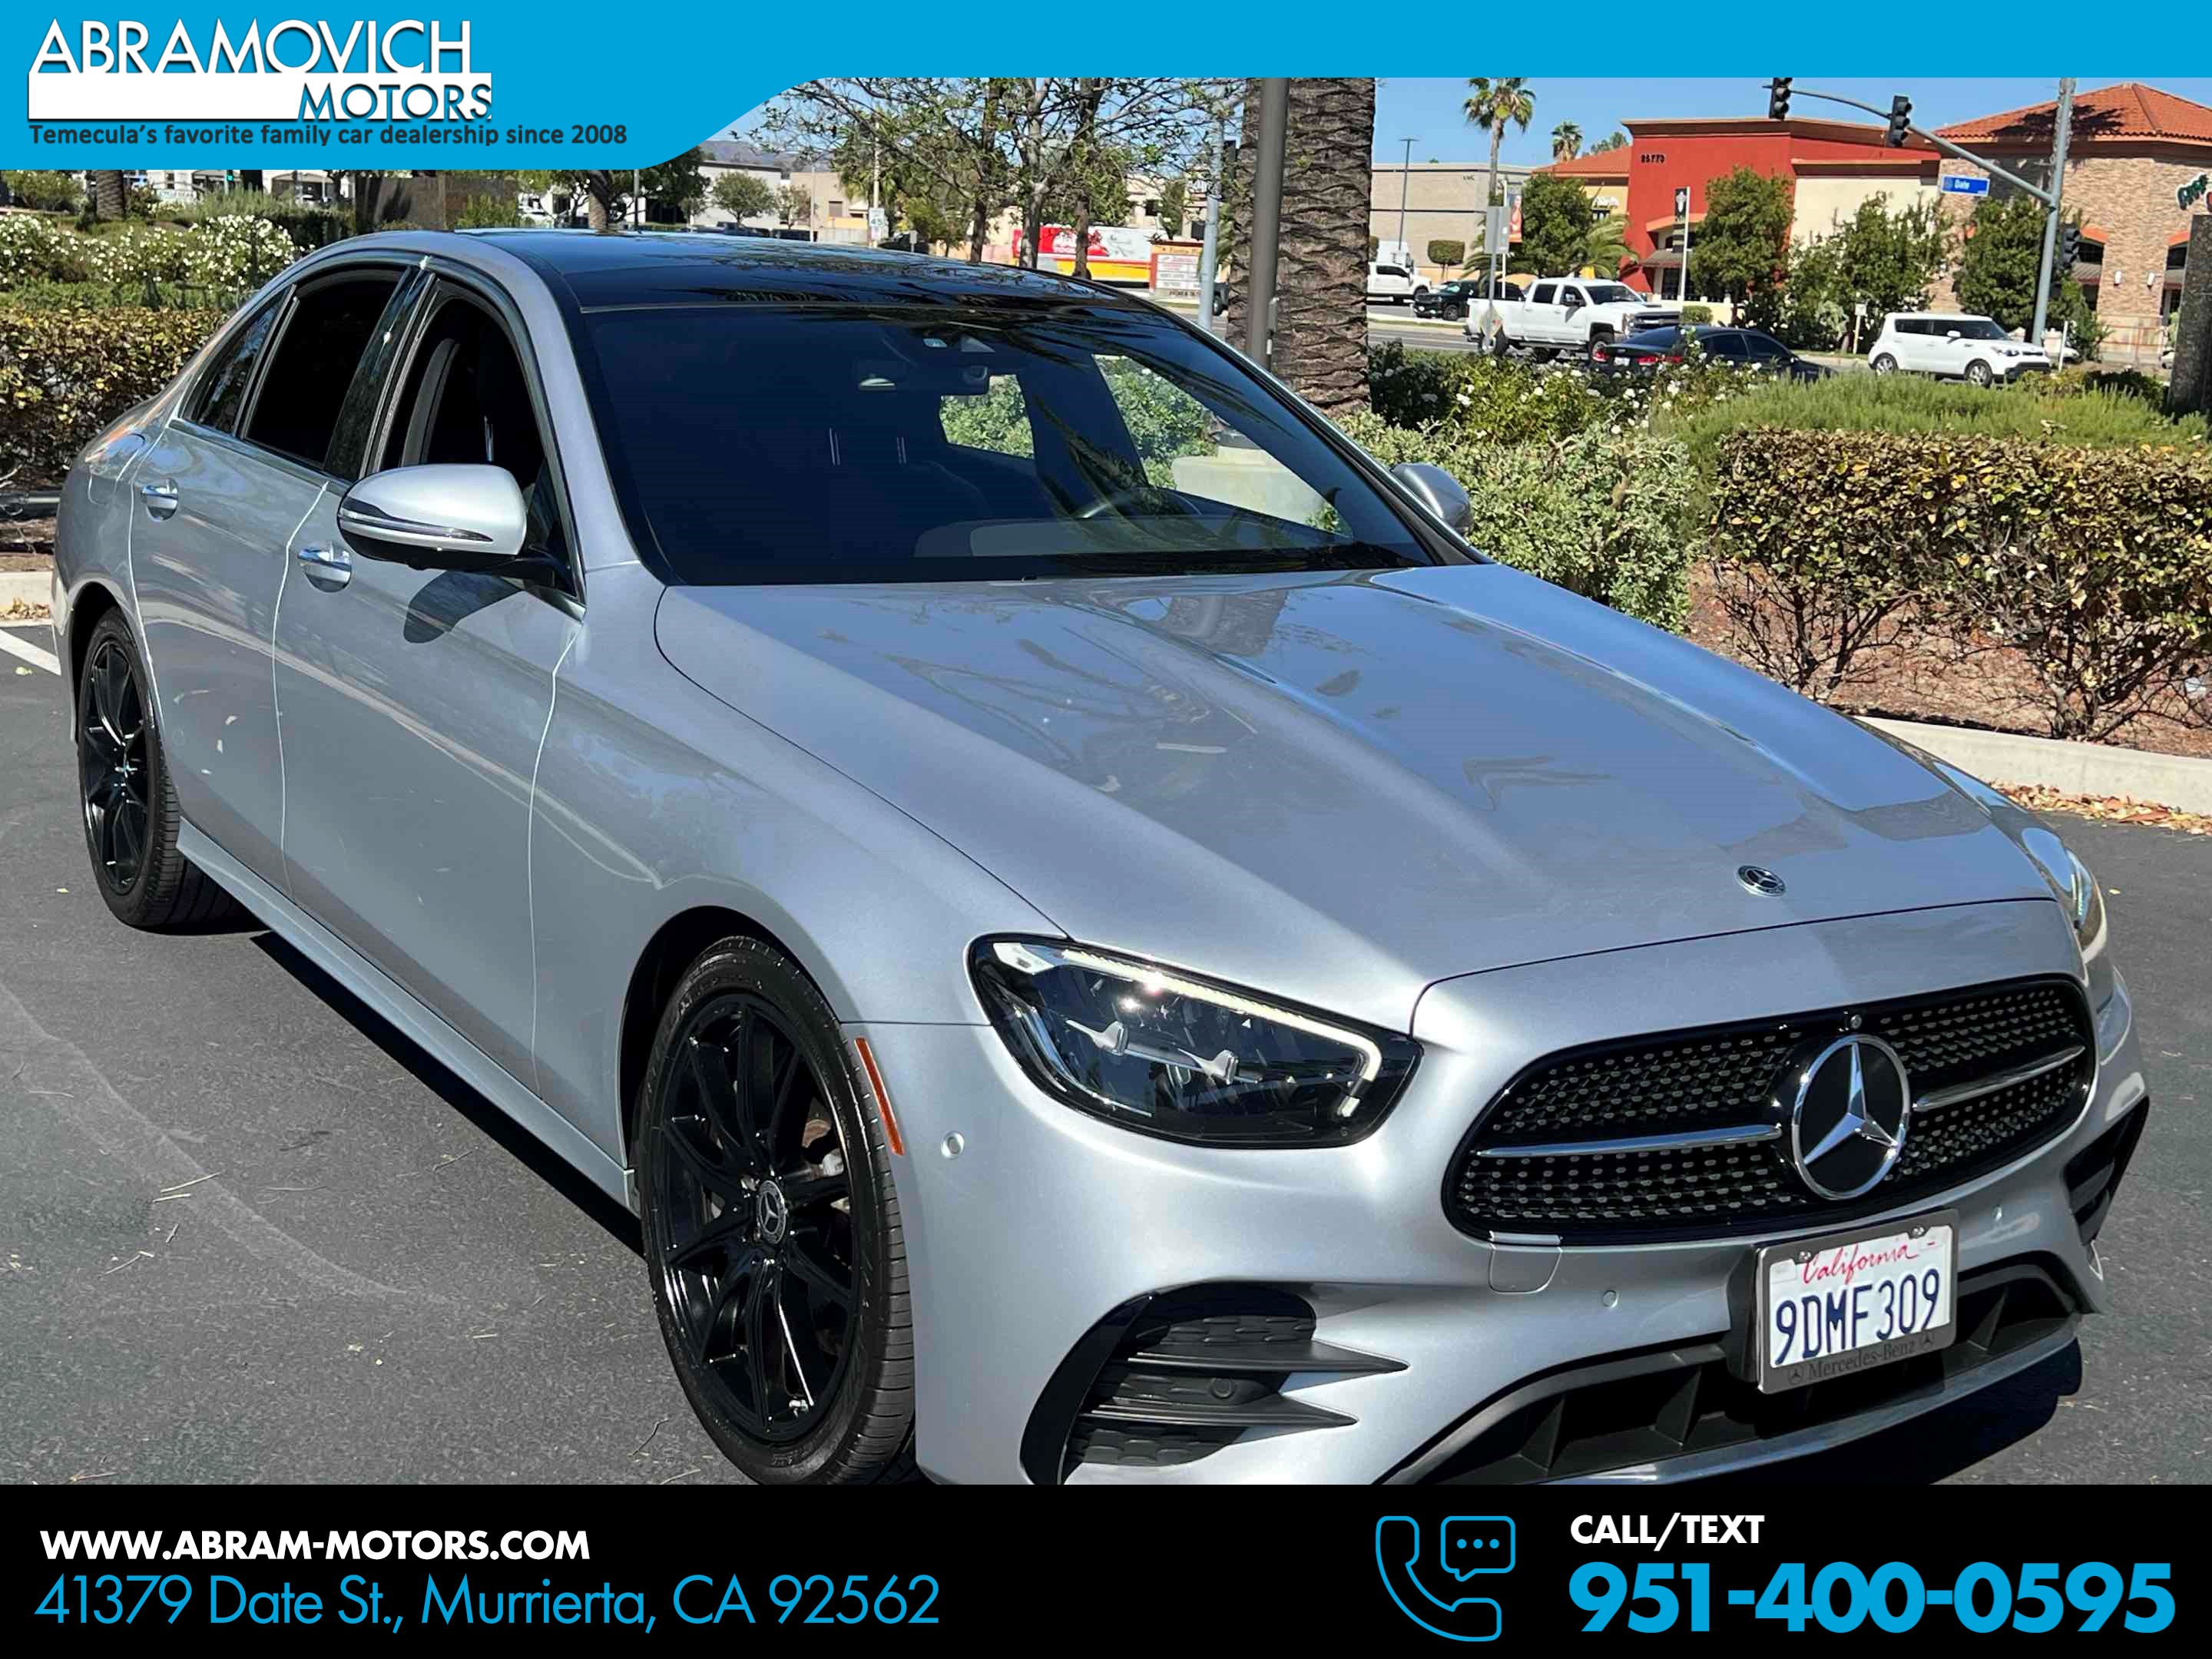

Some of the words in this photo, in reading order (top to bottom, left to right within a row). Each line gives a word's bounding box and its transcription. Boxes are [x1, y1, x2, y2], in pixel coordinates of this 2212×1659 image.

[1802, 1242, 1918, 1284] California
[1775, 1268, 1940, 1366] 9DMF309
[1808, 1341, 1916, 1379] Mercedes-Benz
